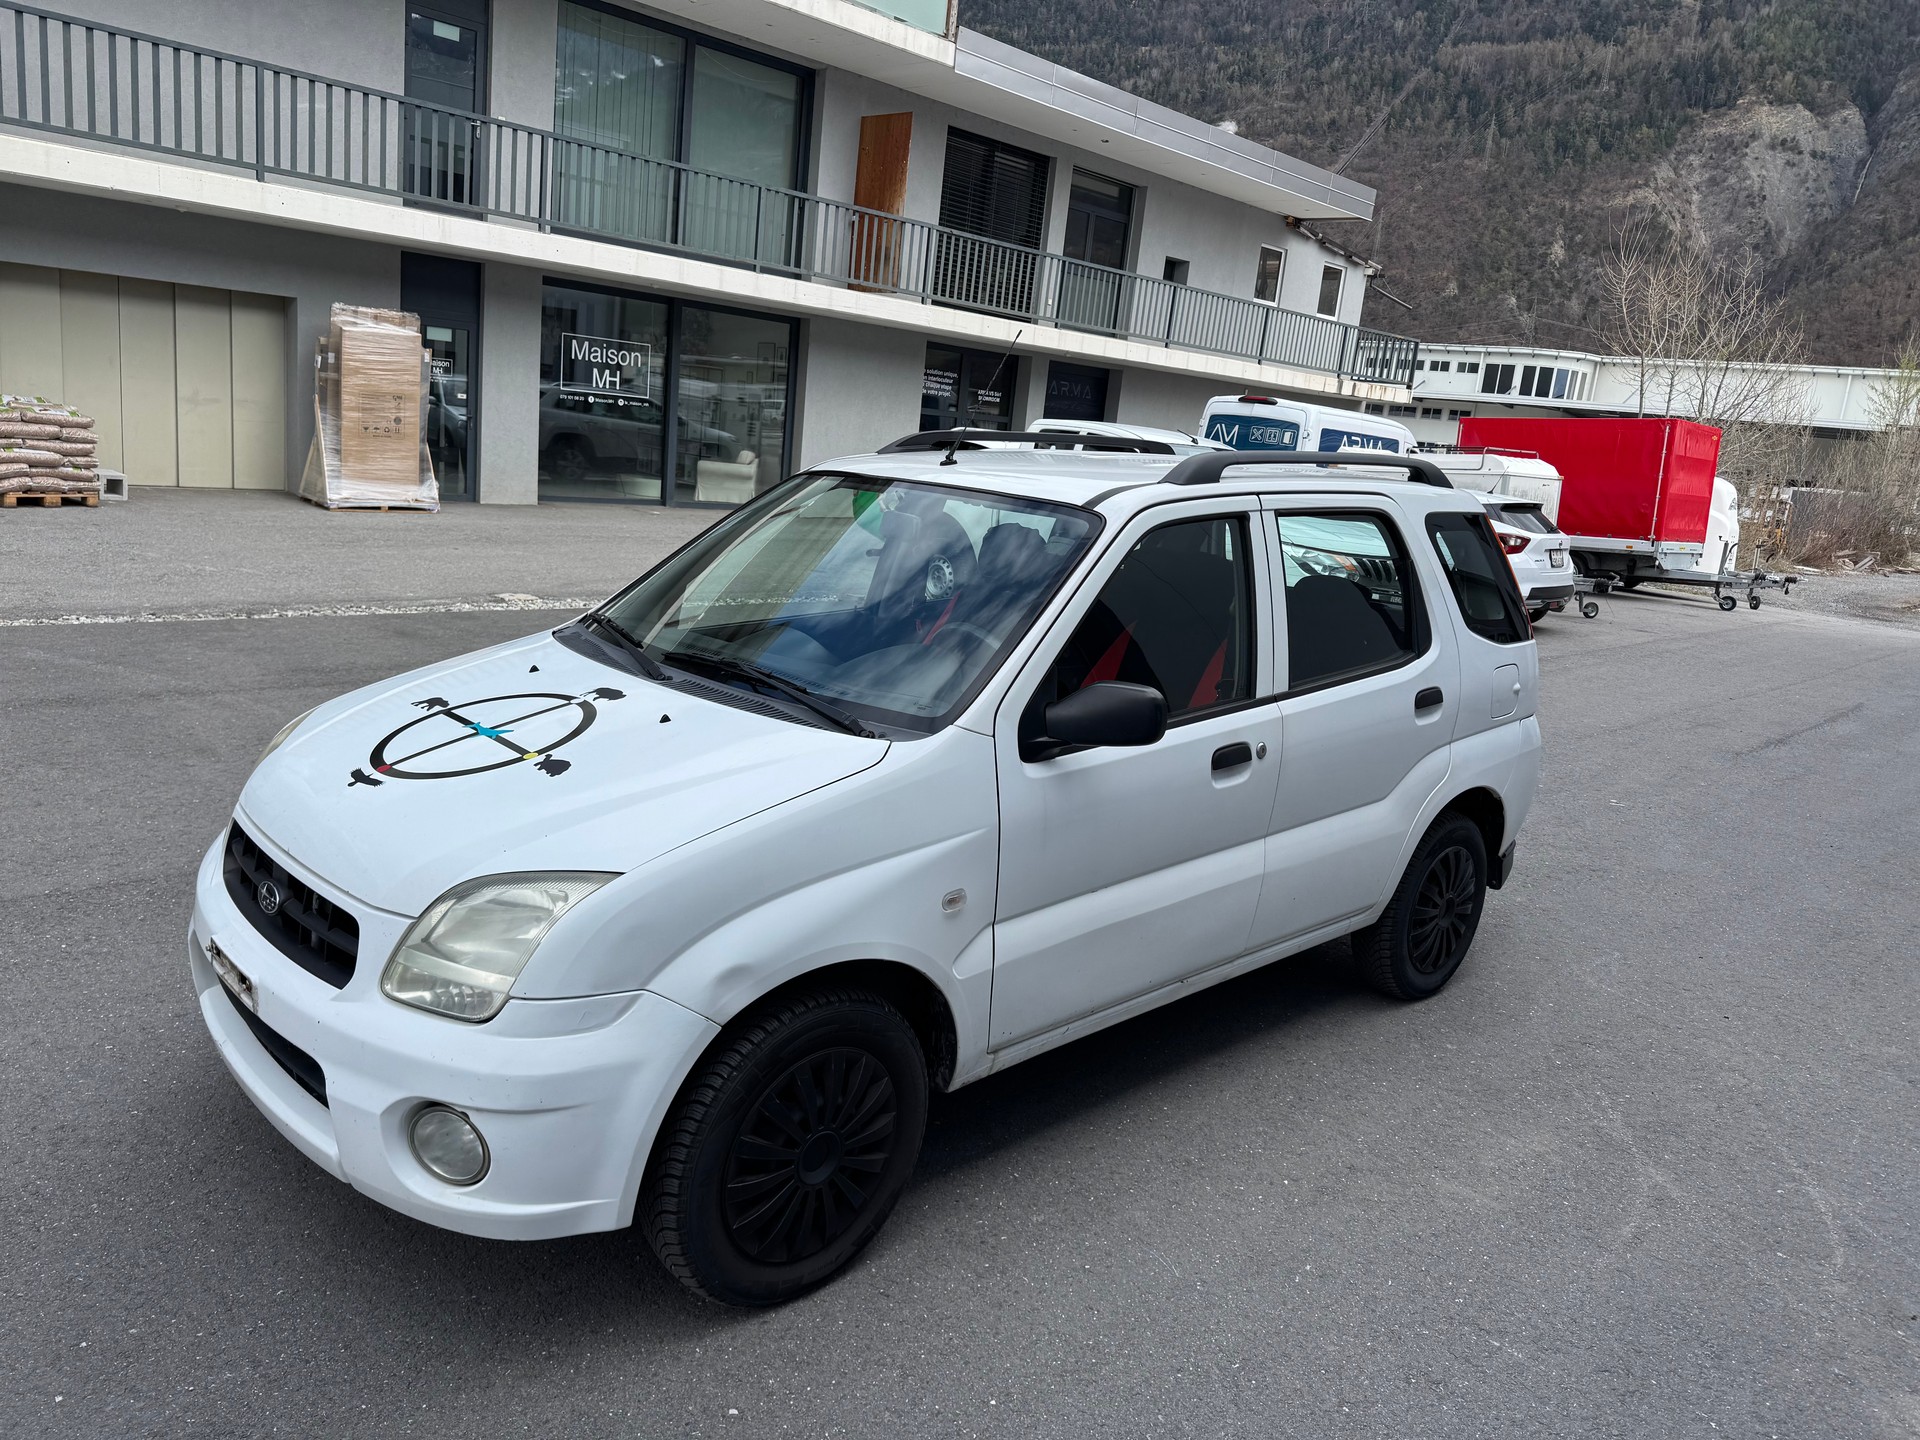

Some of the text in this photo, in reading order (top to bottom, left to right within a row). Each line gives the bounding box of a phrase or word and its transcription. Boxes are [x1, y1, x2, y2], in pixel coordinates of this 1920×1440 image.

[571, 339, 641, 367] Maison
[432, 360, 450, 368] aison
[592, 368, 620, 390] MH
[1048, 380, 1091, 399] ARMA
